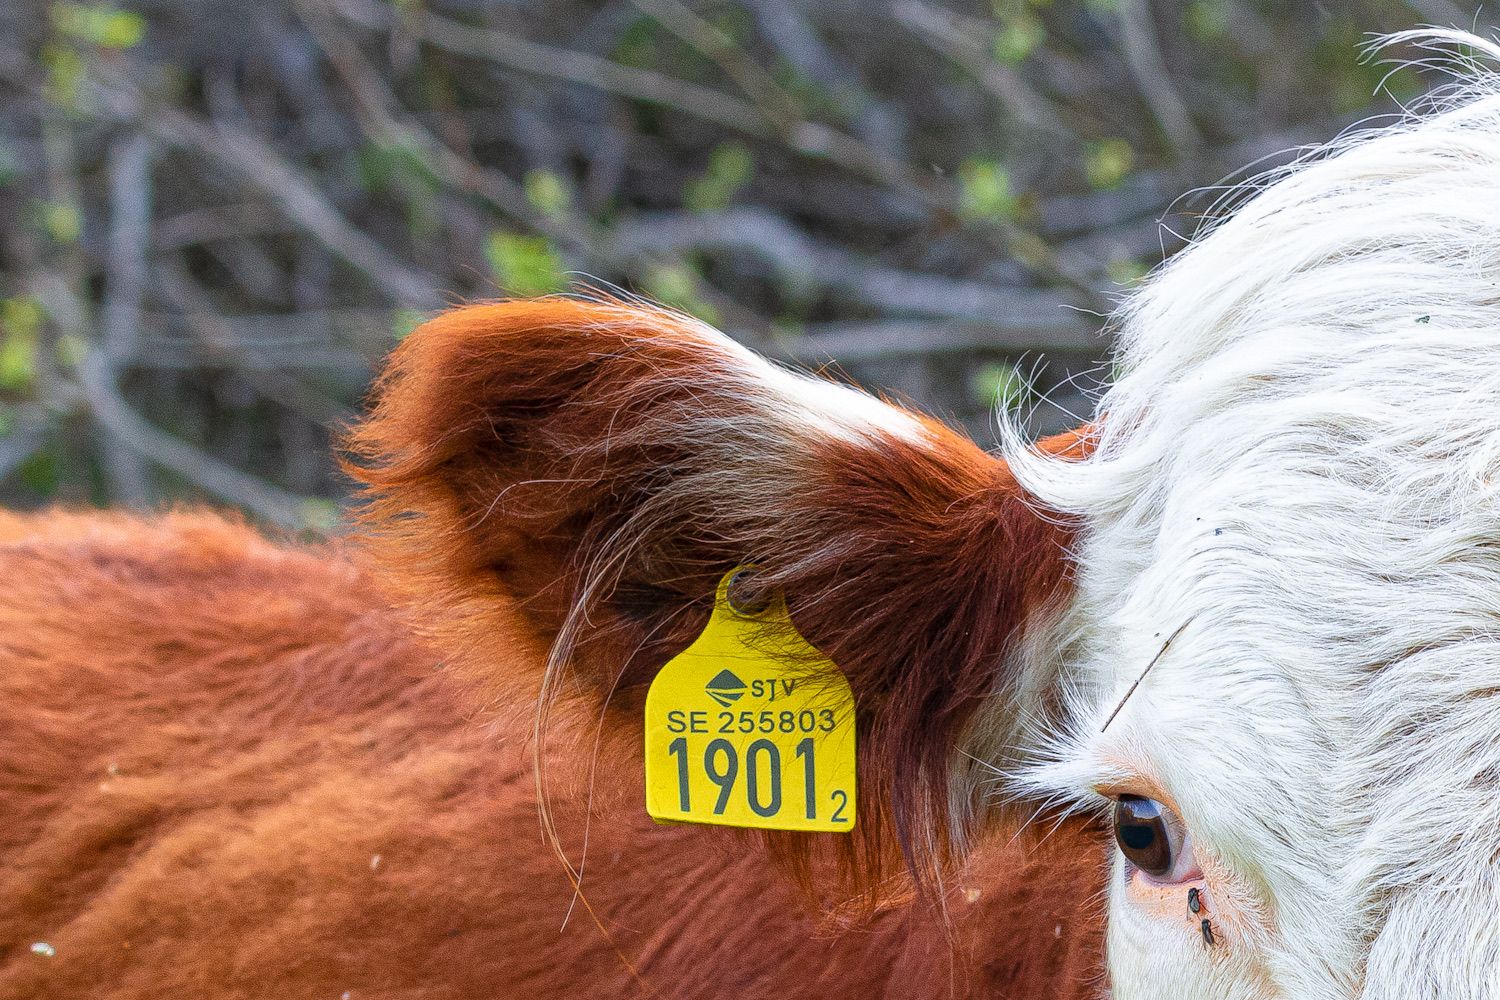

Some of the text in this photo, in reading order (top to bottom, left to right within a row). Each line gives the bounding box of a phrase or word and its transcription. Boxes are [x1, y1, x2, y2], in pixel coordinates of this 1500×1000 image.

[667, 708, 836, 734] SE 255803
[668, 737, 849, 823] 1901 2
